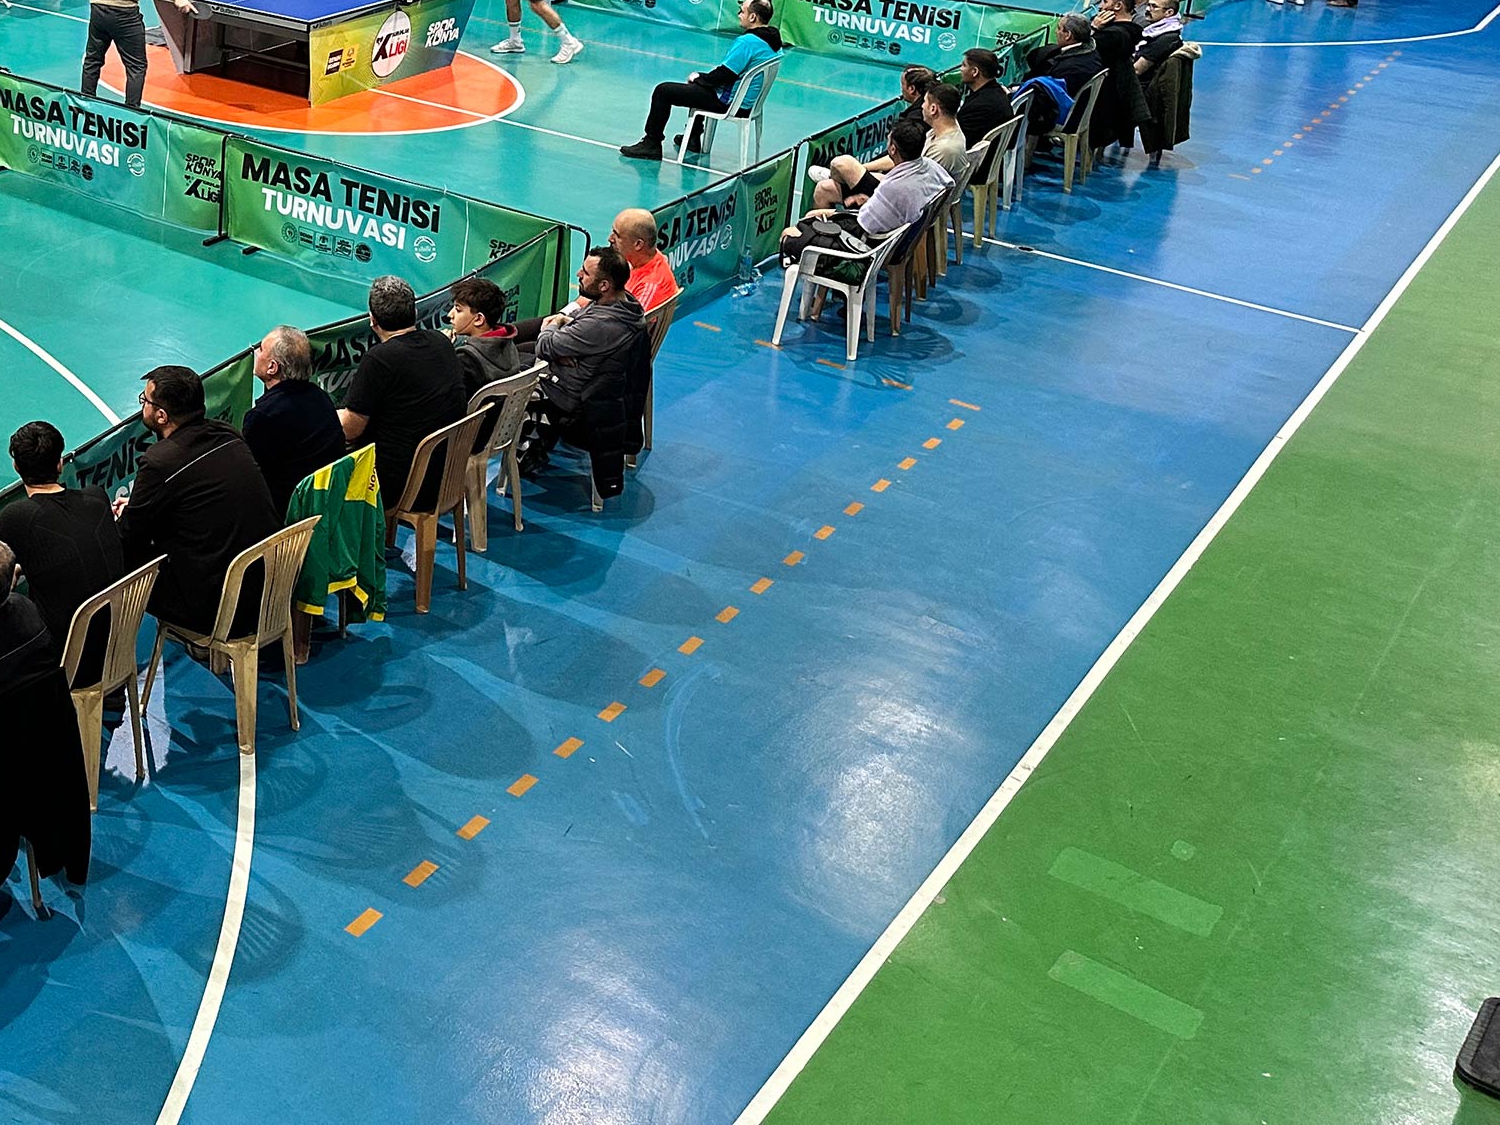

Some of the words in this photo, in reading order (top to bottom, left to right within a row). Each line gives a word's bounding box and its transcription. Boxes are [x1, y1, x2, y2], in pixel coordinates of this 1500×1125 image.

[425, 28, 460, 48] KONYA
[427, 17, 456, 36] SPOR
[812, 6, 932, 45] TURNUVASI
[388, 37, 409, 59] LİGİ
[10, 114, 120, 168] TURNUVASI
[69, 105, 148, 150] TENİSİ
[185, 153, 216, 169] SPOR
[241, 153, 333, 203] MASA
[340, 178, 440, 234] TENİSİ
[754, 186, 773, 203] SPOR
[754, 195, 778, 213] KONYA
[261, 188, 406, 250] TURNUVASI
[686, 191, 738, 238] TENİSİ
